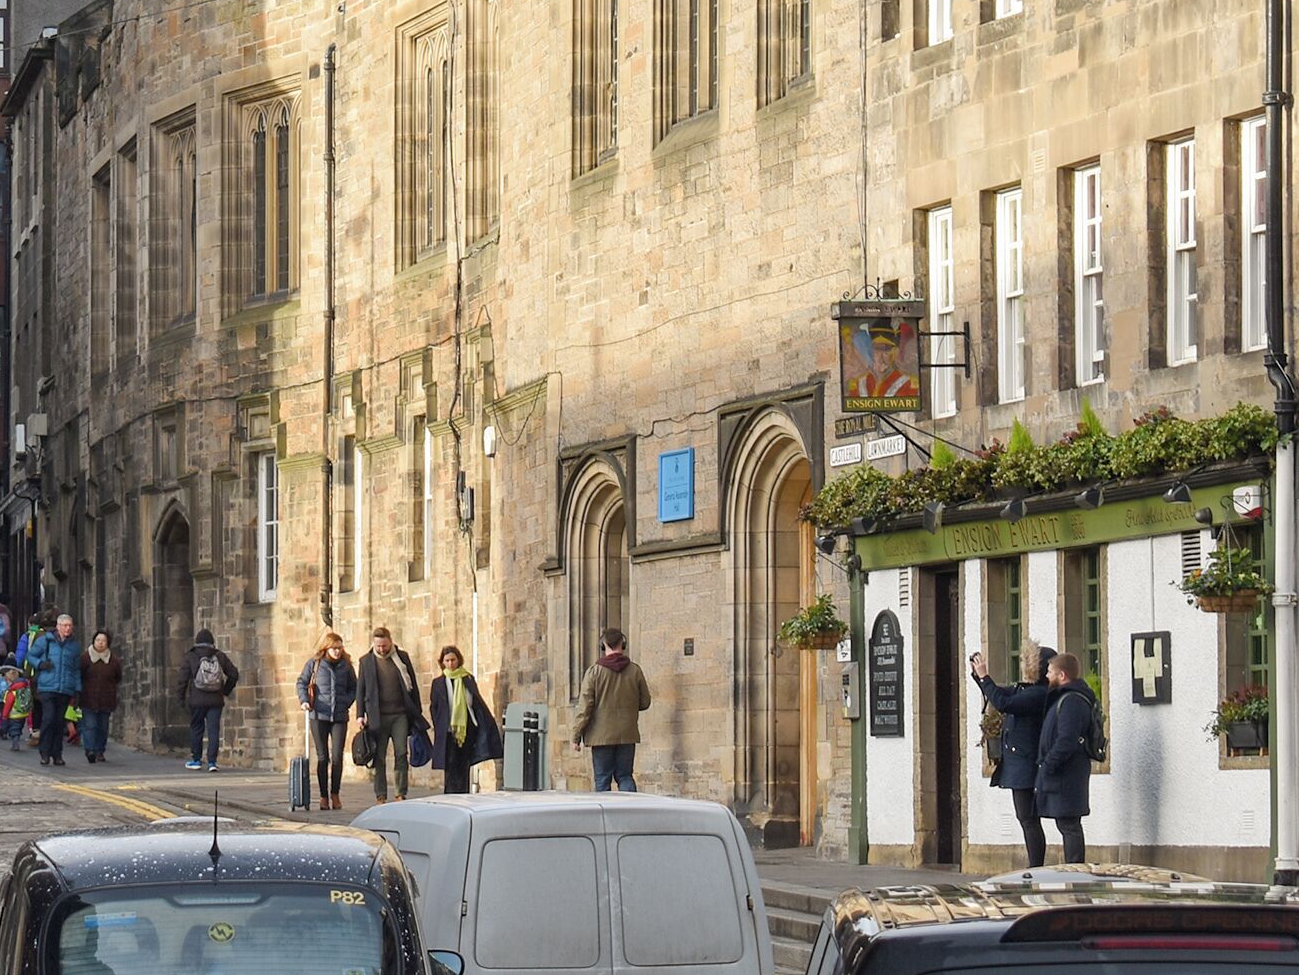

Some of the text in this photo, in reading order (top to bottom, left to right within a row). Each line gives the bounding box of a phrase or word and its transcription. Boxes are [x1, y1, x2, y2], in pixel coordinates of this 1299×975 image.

[846, 398, 918, 409] ENSIGN EWART
[953, 523, 1003, 555] ENSIGN
[1009, 516, 1061, 548] EWART
[330, 890, 366, 905] P82
